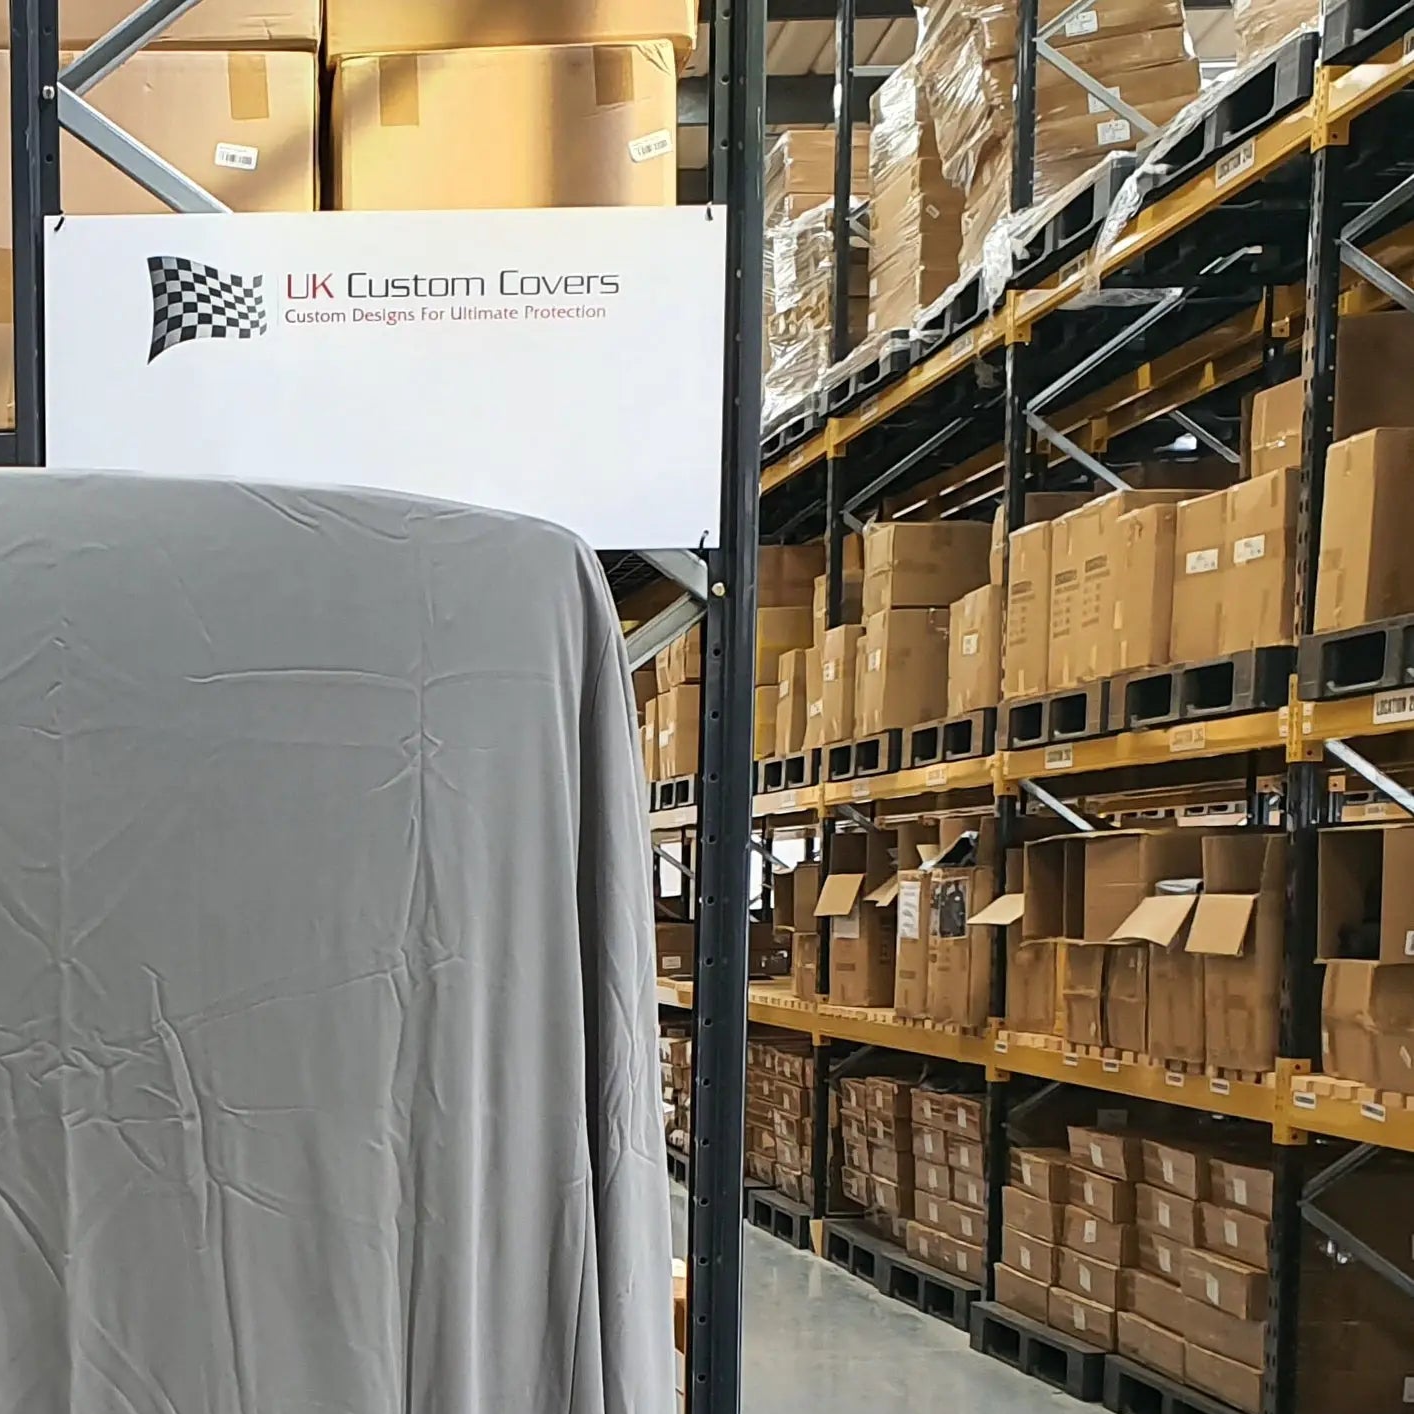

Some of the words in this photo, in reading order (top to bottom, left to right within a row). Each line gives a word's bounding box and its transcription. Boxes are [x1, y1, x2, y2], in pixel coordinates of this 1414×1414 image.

[287, 273, 335, 300] UK
[347, 272, 486, 299] Custom
[499, 269, 620, 296] Covers
[284, 307, 346, 324] Custom
[352, 307, 415, 326] Designs
[421, 305, 445, 321] For
[450, 305, 519, 321] Ultimate
[524, 303, 606, 319] Protection
